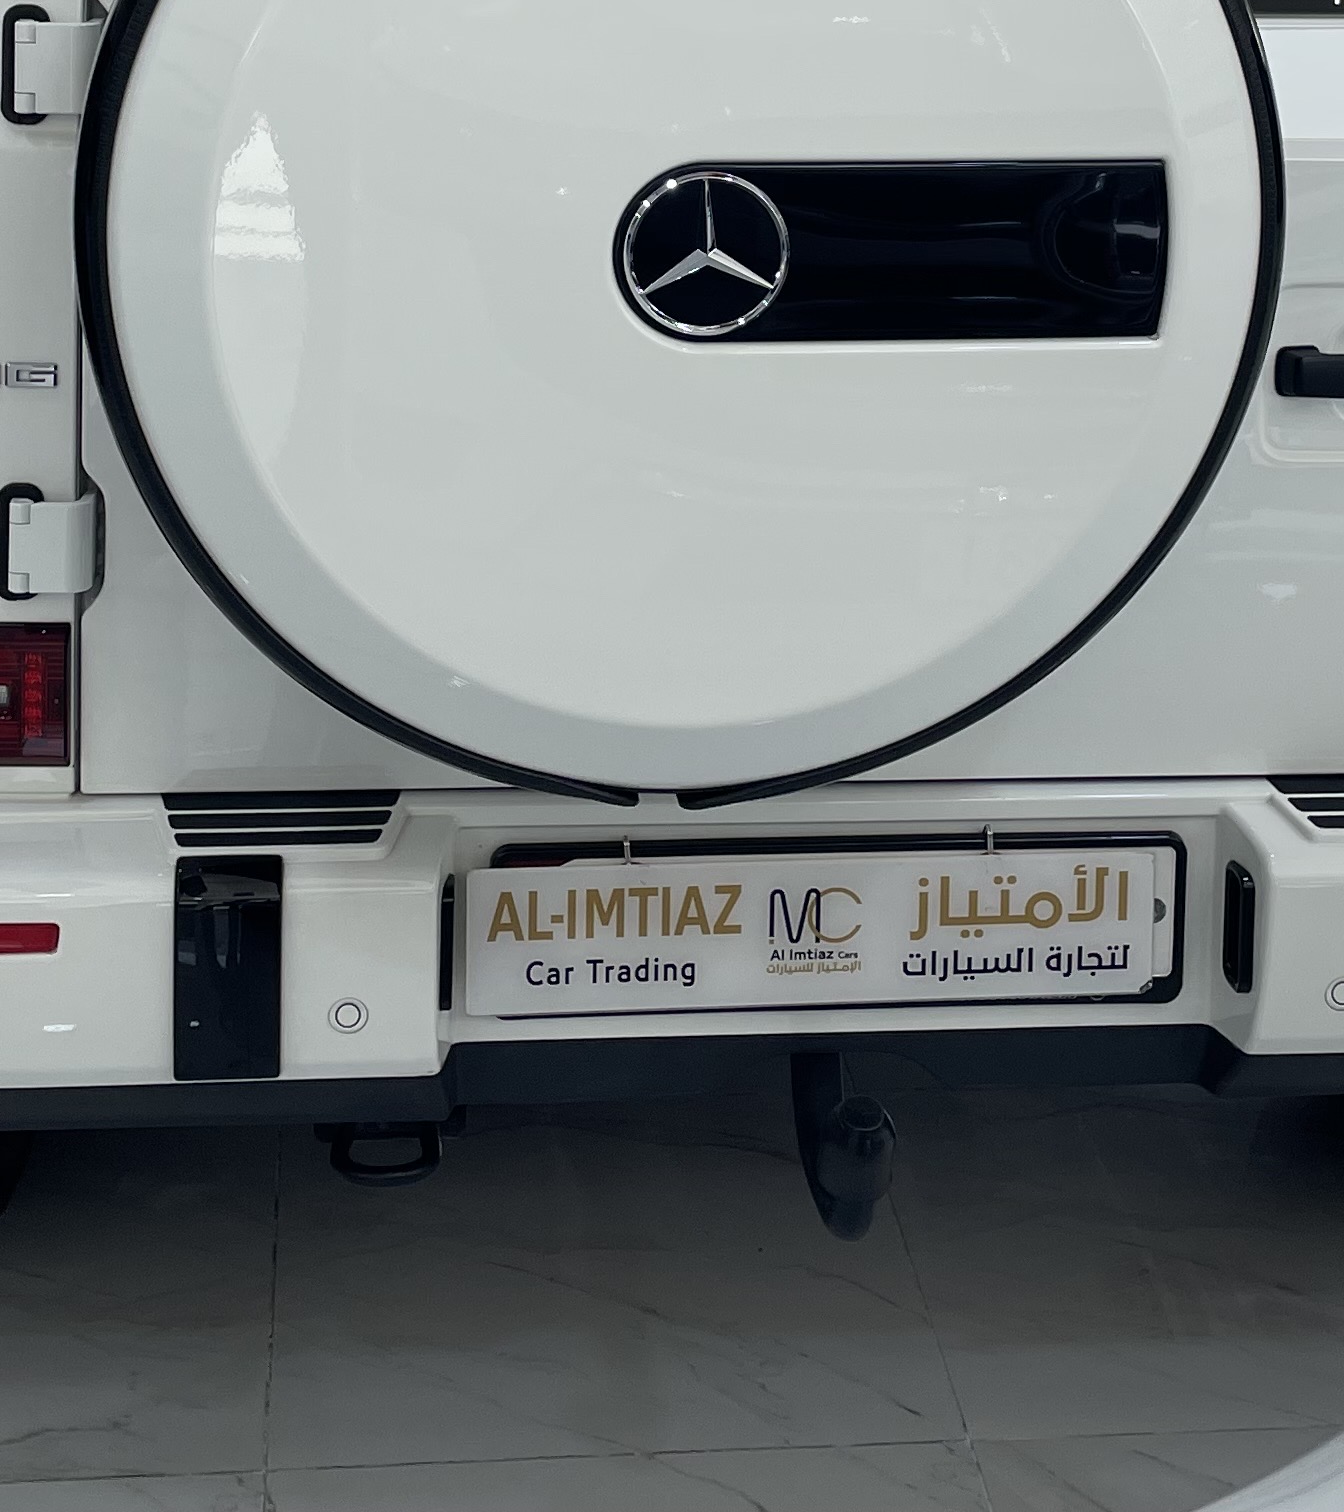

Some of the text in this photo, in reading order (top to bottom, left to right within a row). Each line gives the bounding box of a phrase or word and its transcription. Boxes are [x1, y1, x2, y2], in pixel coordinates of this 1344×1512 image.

[487, 884, 742, 943] AL-IMTIAZ
[909, 864, 1129, 941] الأمتياز
[526, 957, 696, 987] Car Trading
[770, 948, 858, 961] Al Imtiaz Cars
[902, 944, 1130, 982] لتجارة السيارات
